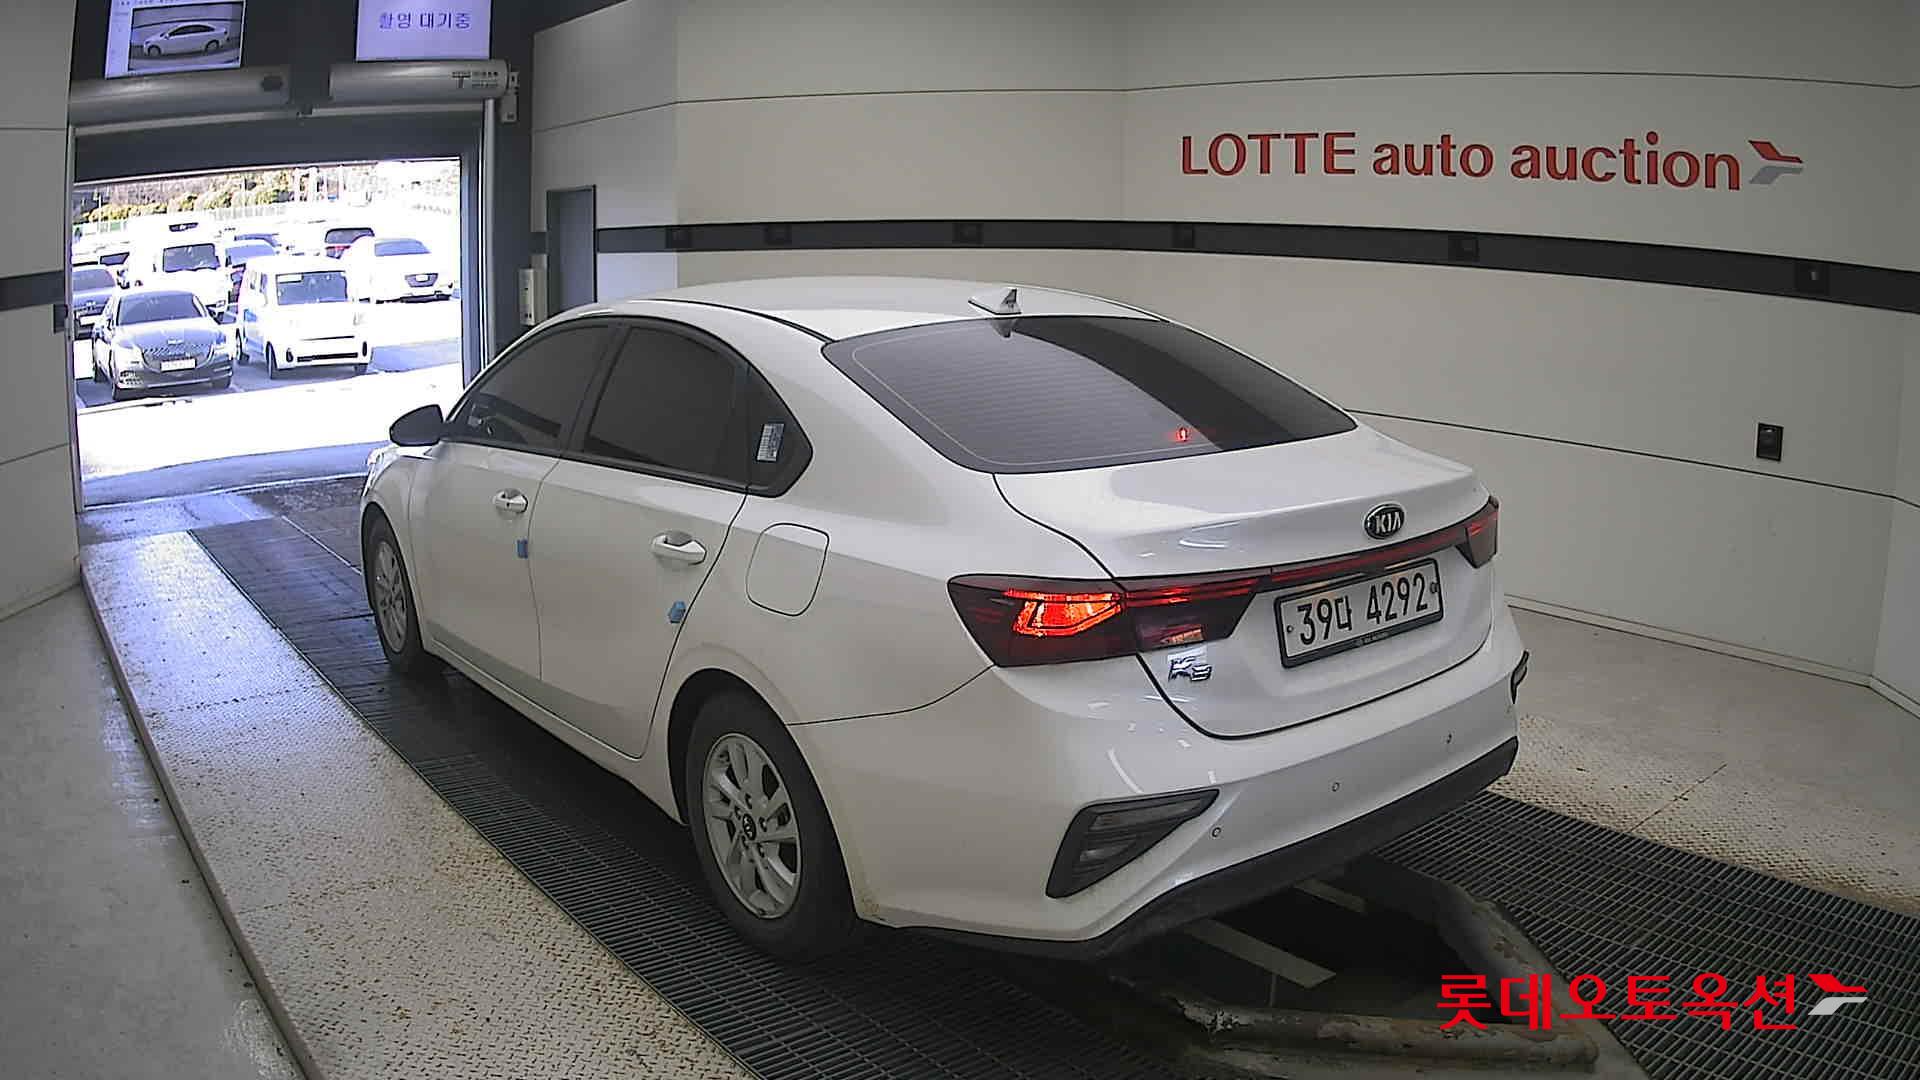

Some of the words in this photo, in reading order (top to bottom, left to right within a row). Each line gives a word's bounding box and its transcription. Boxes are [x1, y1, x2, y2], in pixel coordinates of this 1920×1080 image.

[419, 12, 470, 29] 대기중
[1182, 131, 1356, 176] LOTTE
[1373, 133, 1494, 178] auto
[1510, 130, 1741, 191] auction
[1375, 511, 1402, 534] KIA
[1297, 595, 1353, 646] 39다
[1366, 572, 1429, 625] 4292
